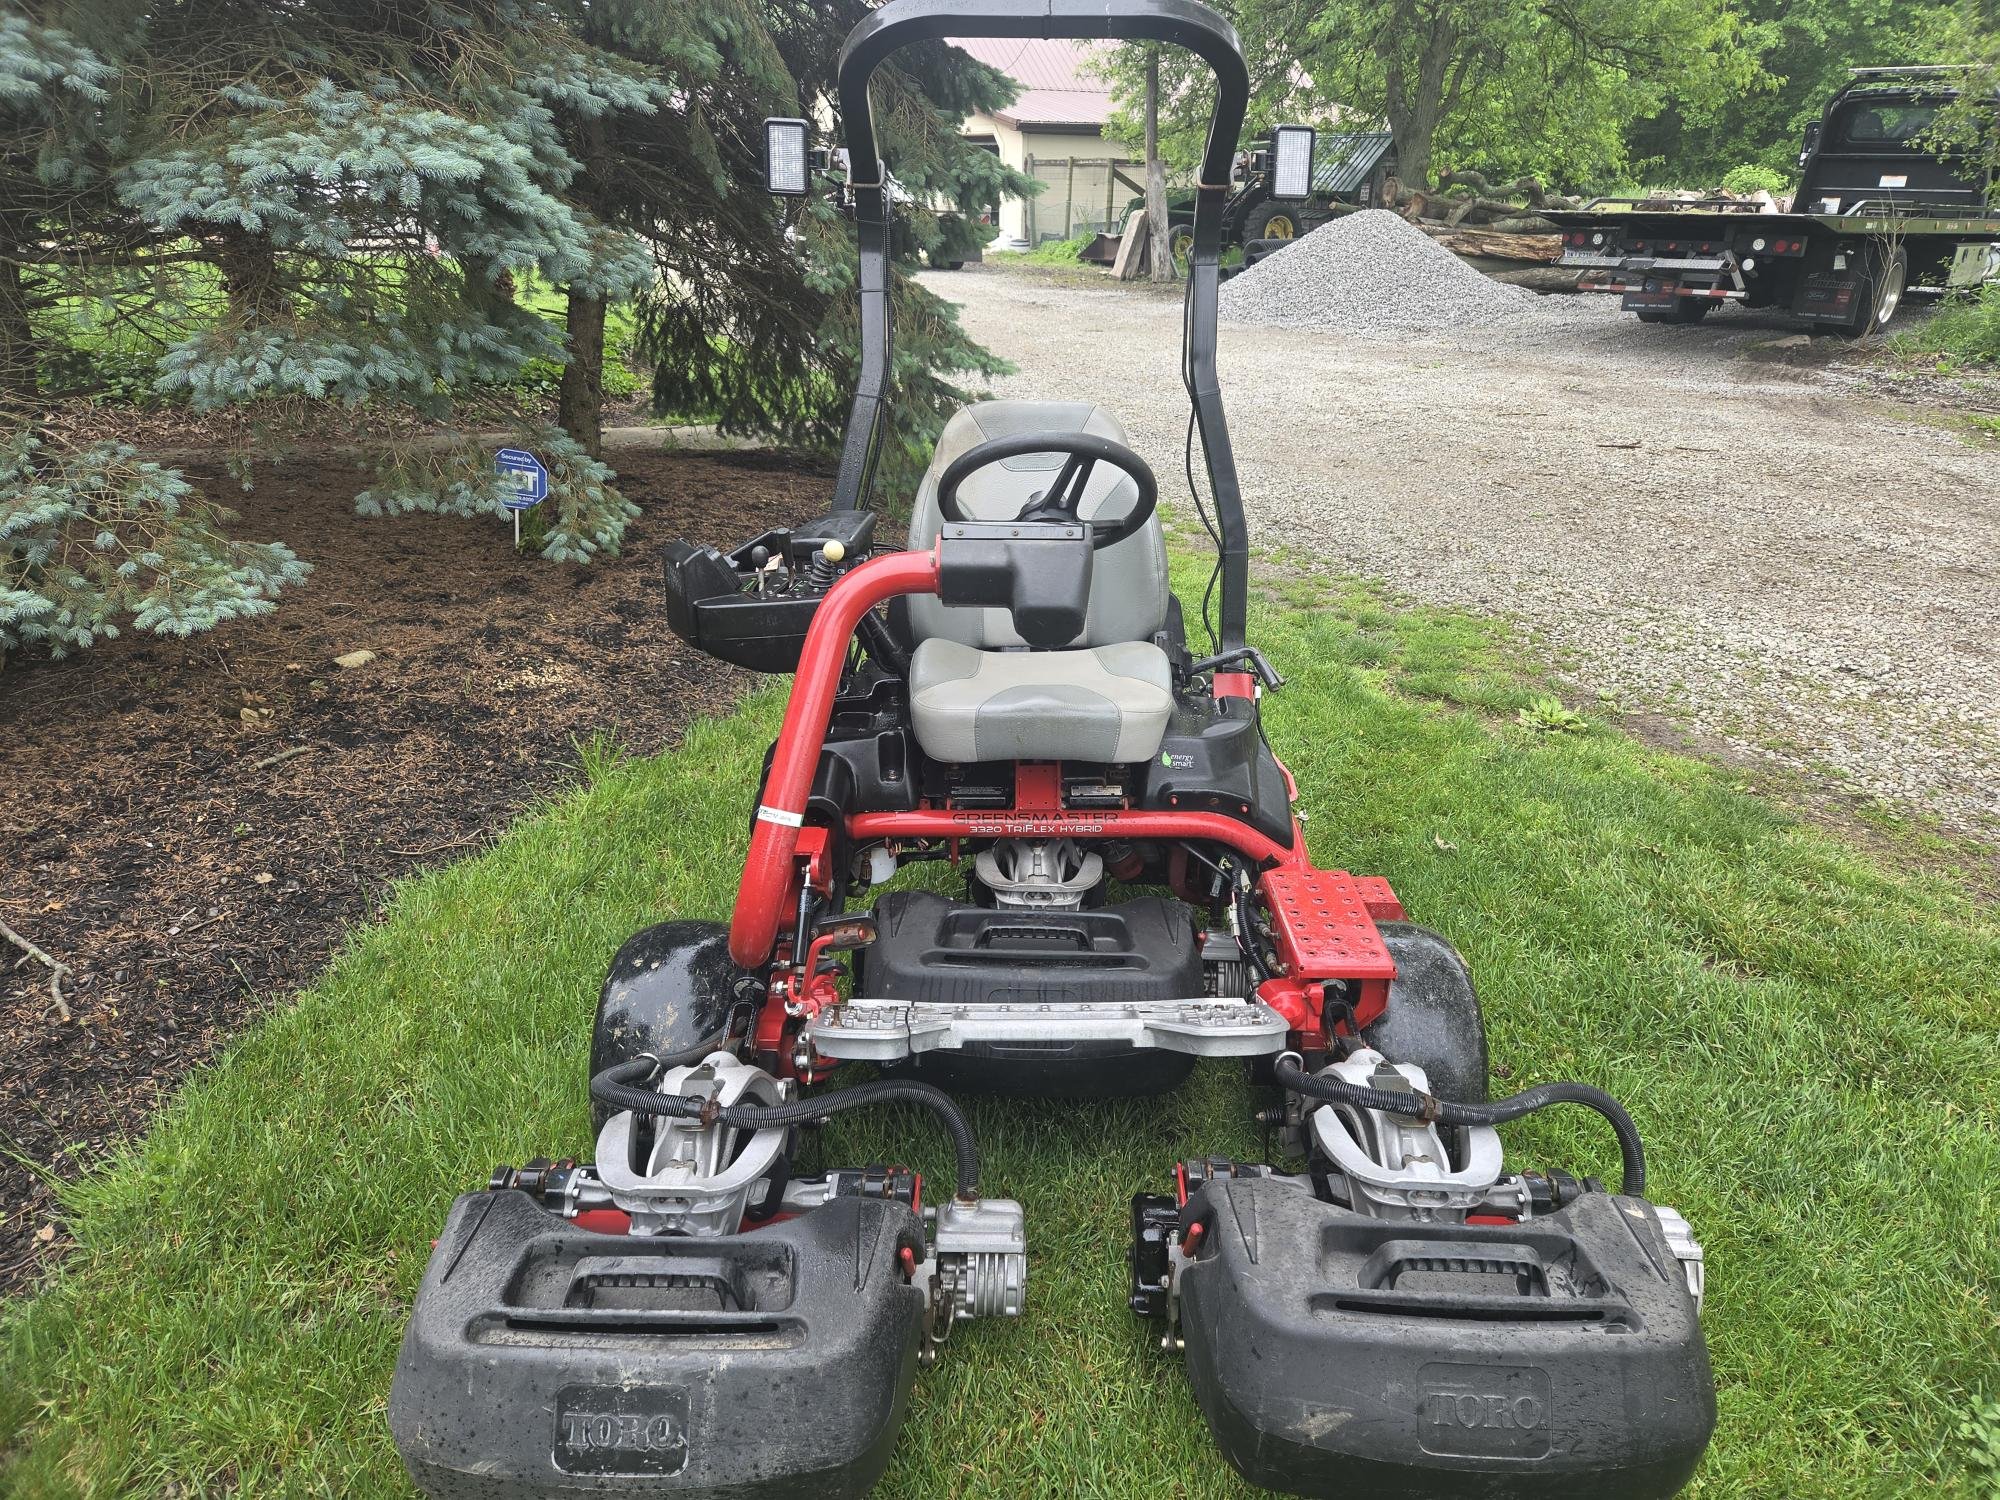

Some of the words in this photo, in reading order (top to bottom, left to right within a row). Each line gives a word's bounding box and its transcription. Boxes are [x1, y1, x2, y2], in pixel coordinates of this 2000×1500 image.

[501, 453, 524, 462] Secured
[1171, 754, 1193, 762] energy
[1172, 760, 1192, 768] smart
[953, 812, 1118, 825] GREENSMASTER
[1060, 825, 1103, 833] HYBRID
[1429, 1392, 1542, 1429] TORO
[563, 1411, 679, 1453] TORO
